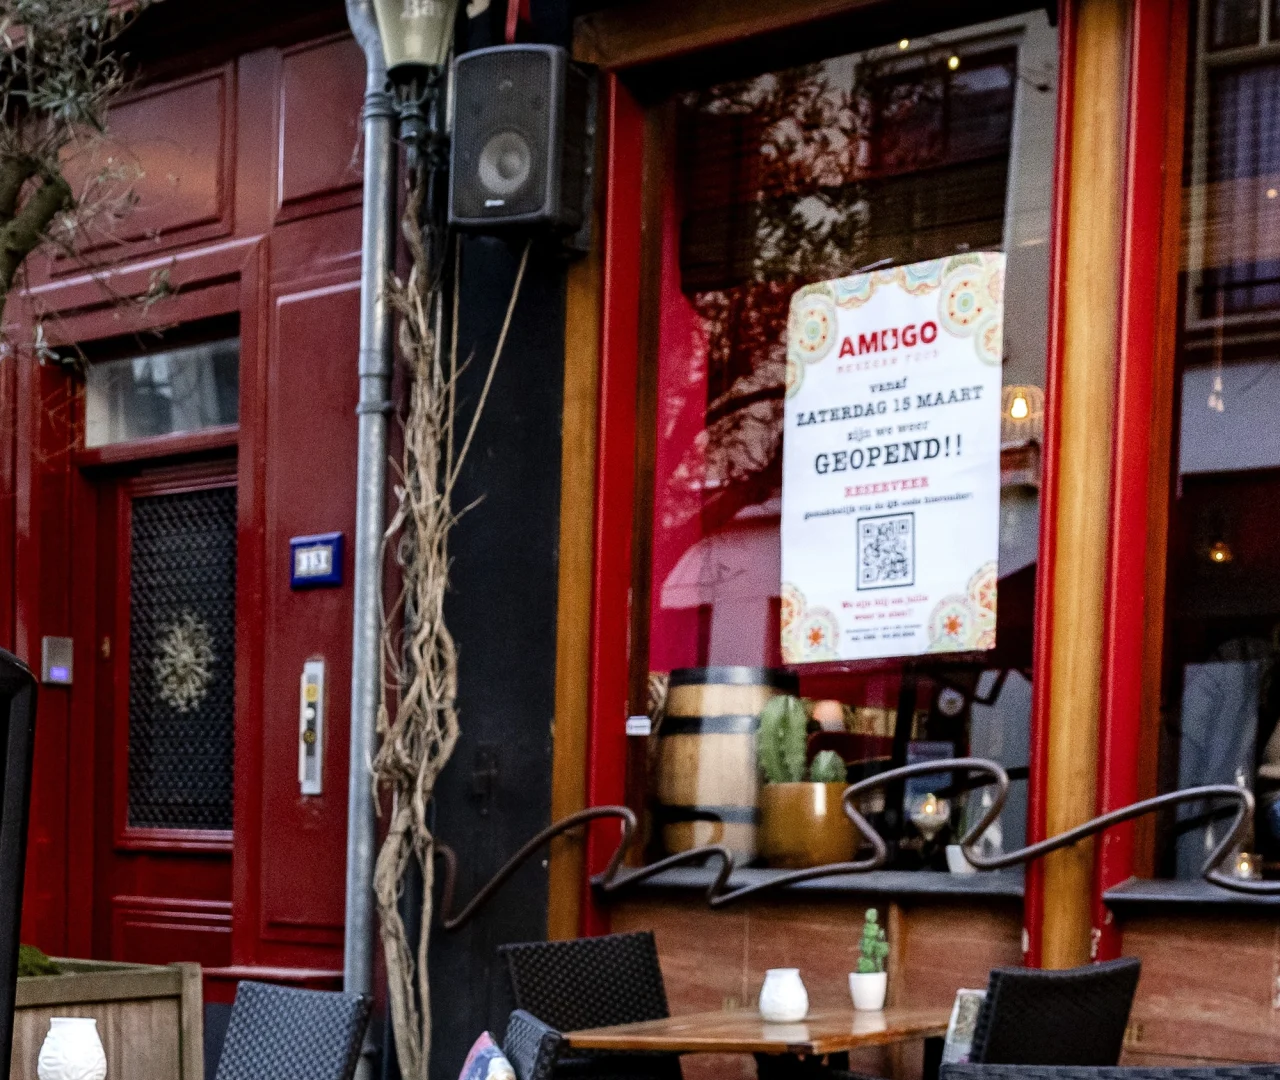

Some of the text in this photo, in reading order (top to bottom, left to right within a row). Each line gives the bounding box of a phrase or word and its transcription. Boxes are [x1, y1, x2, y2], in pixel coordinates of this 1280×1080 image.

[796, 385, 984, 427] ZATERDAG 15 MAART
[815, 434, 963, 475] GEOPEND!!
